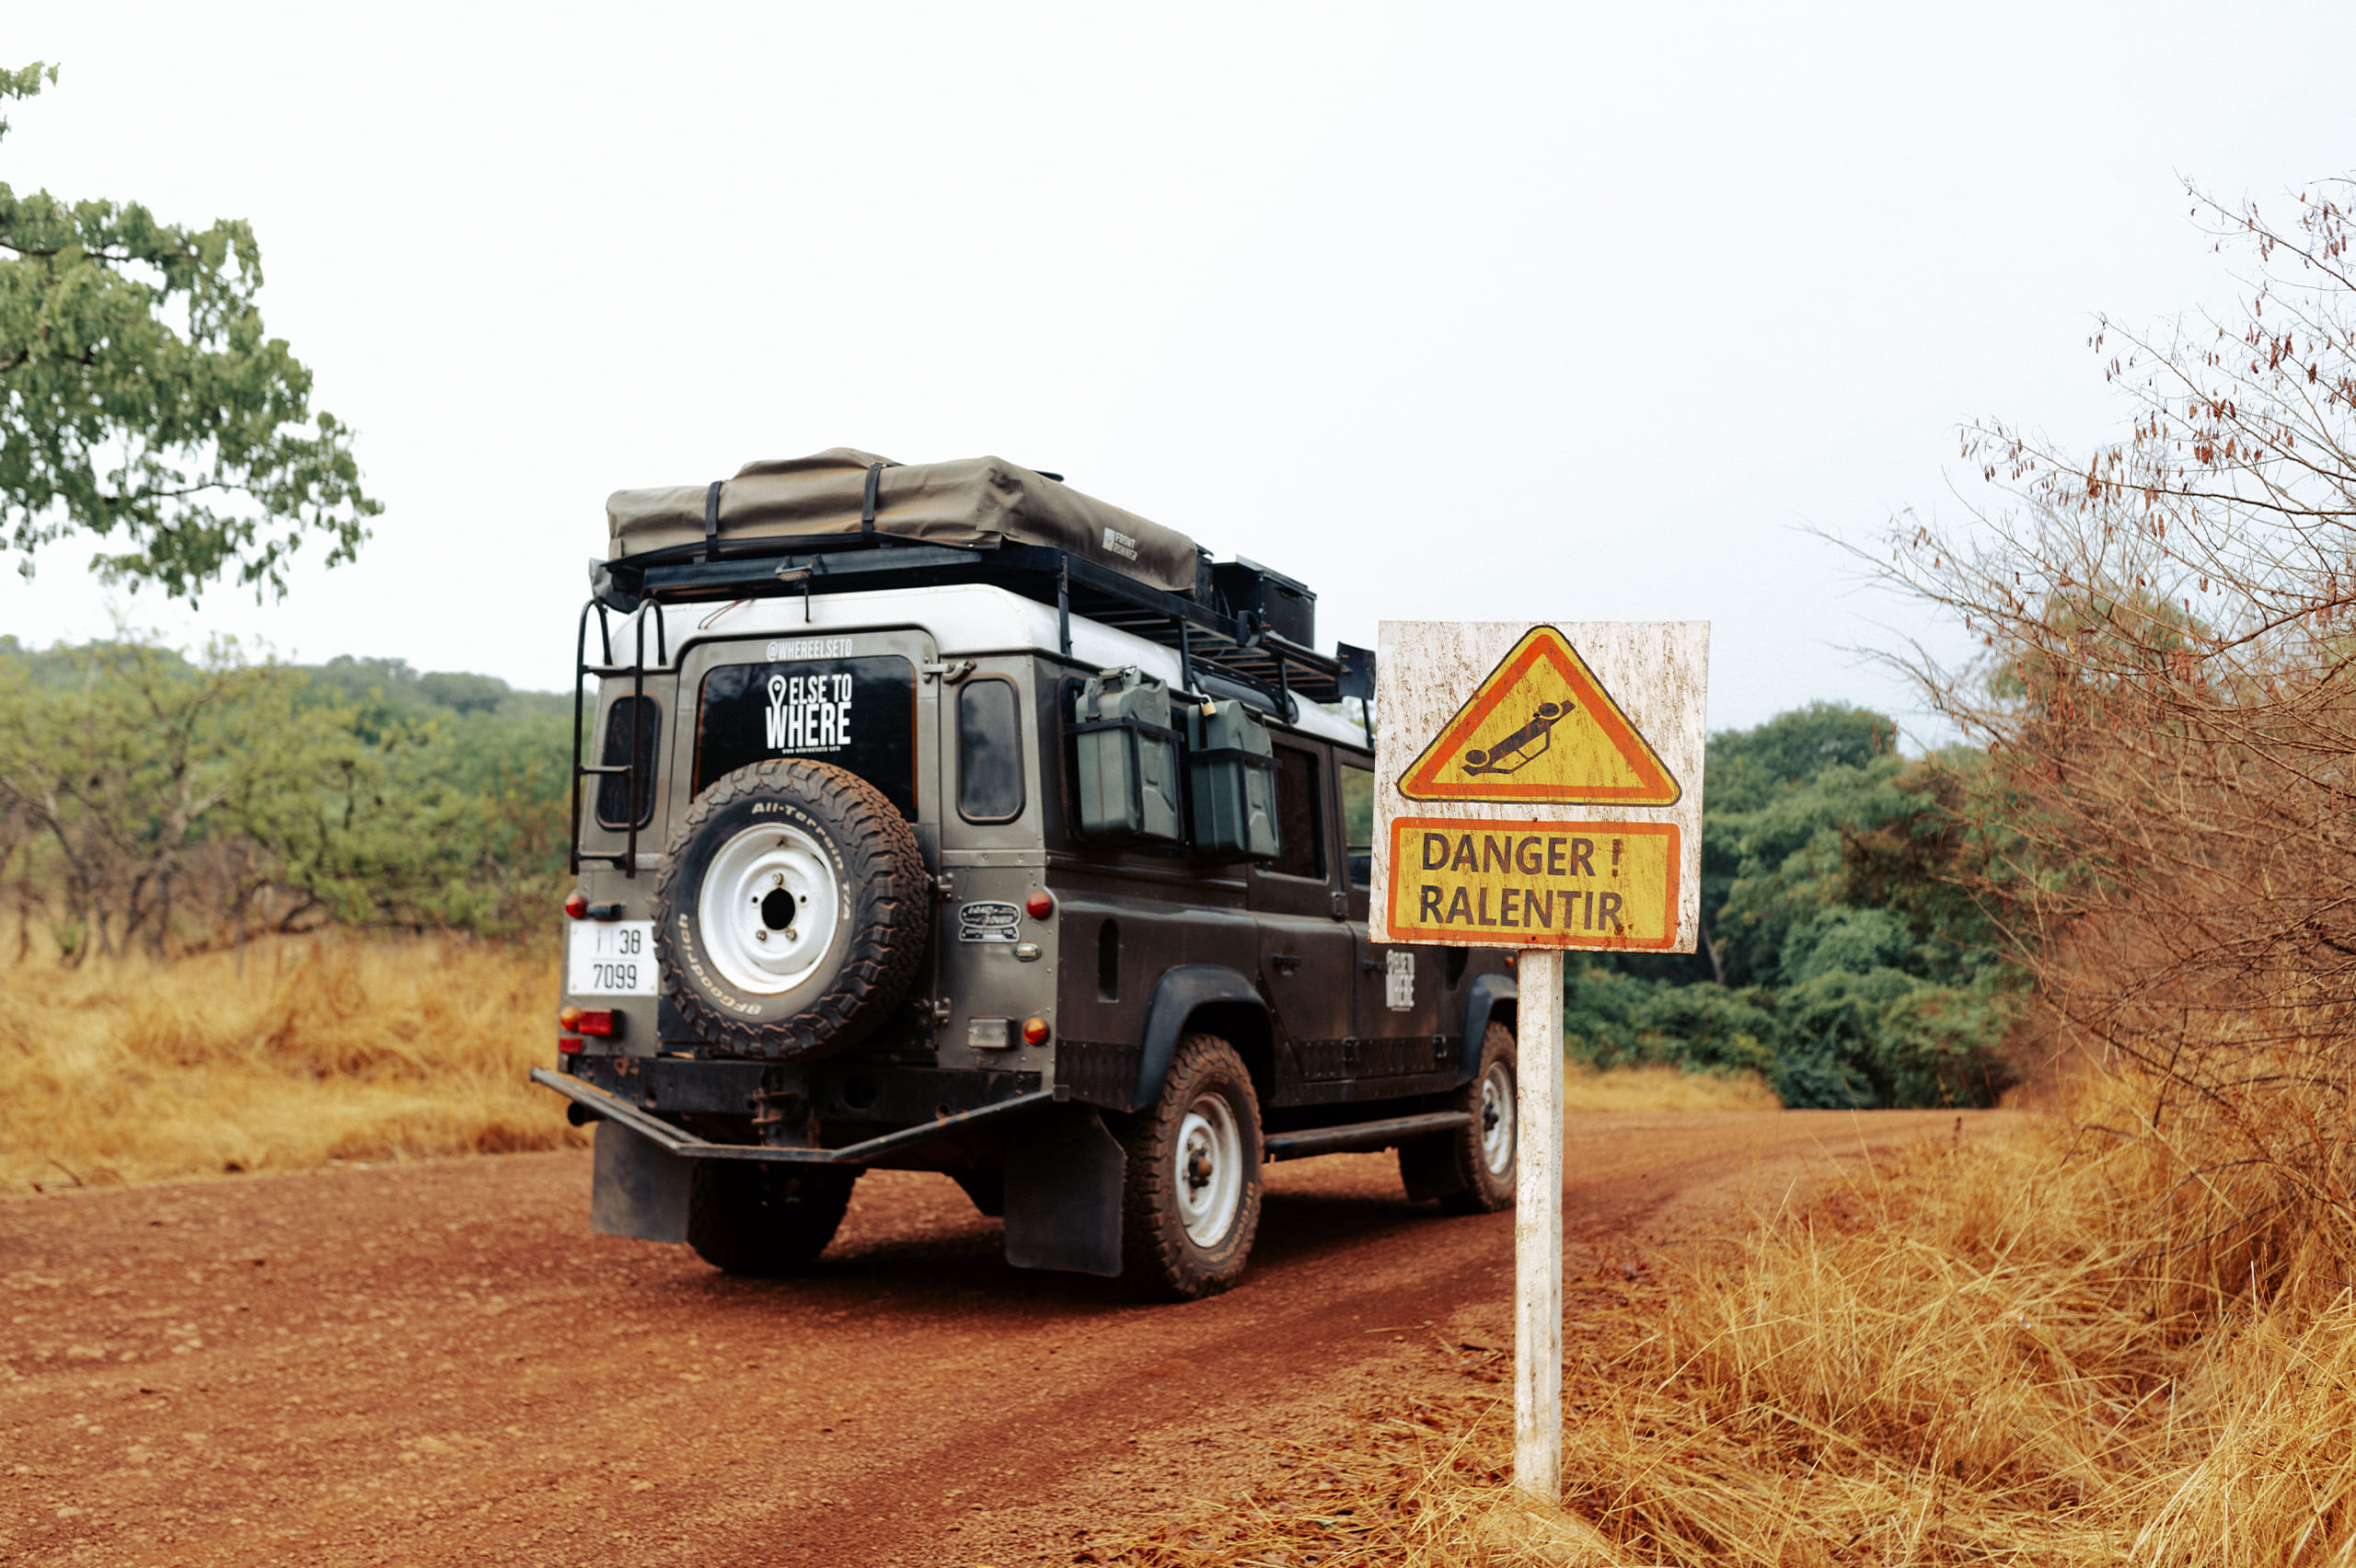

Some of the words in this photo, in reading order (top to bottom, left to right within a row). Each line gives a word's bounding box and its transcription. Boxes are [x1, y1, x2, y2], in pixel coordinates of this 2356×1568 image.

[767, 639, 852, 662] @WHEREELSETO
[789, 675, 827, 705] ELSE
[832, 674, 852, 702] TO
[766, 702, 851, 749] WHERE
[752, 801, 843, 870] All-Terrain
[1422, 832, 1596, 877] DANGER
[1420, 884, 1623, 934] RALENTIR
[619, 929, 641, 954] 38
[593, 963, 637, 990] 7099
[678, 913, 763, 1016] BFGoodrich
